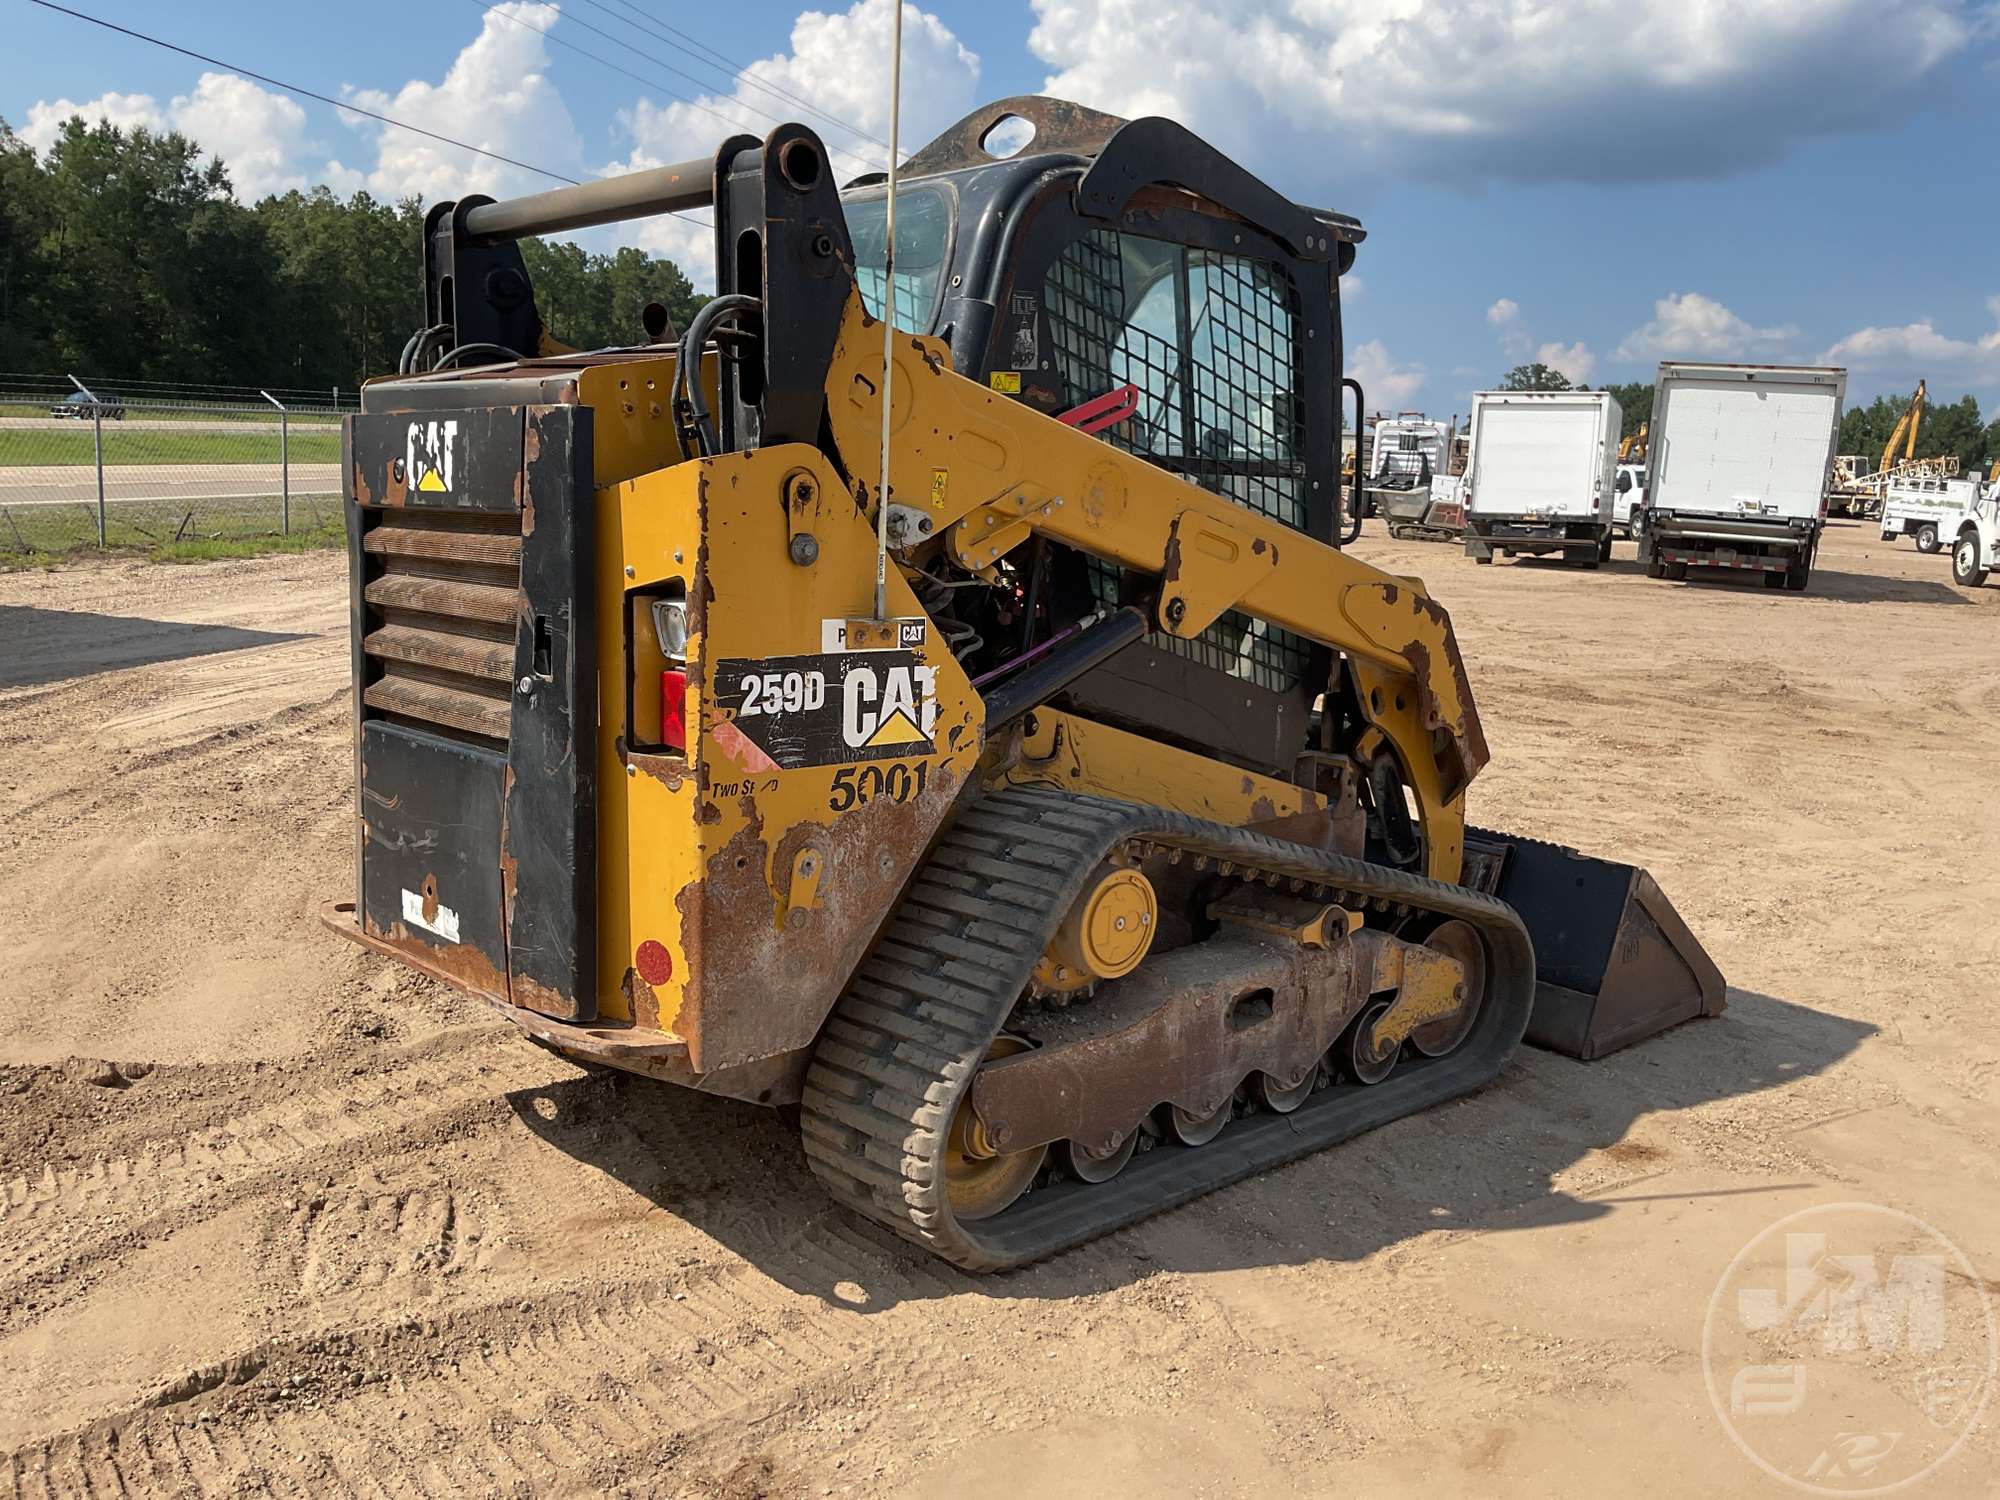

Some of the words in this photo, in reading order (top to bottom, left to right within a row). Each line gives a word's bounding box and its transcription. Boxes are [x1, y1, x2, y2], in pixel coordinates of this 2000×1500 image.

[406, 420, 458, 492] CAT
[902, 625, 924, 642] CAT
[740, 670, 825, 717] 259D
[842, 665, 940, 748] CAT
